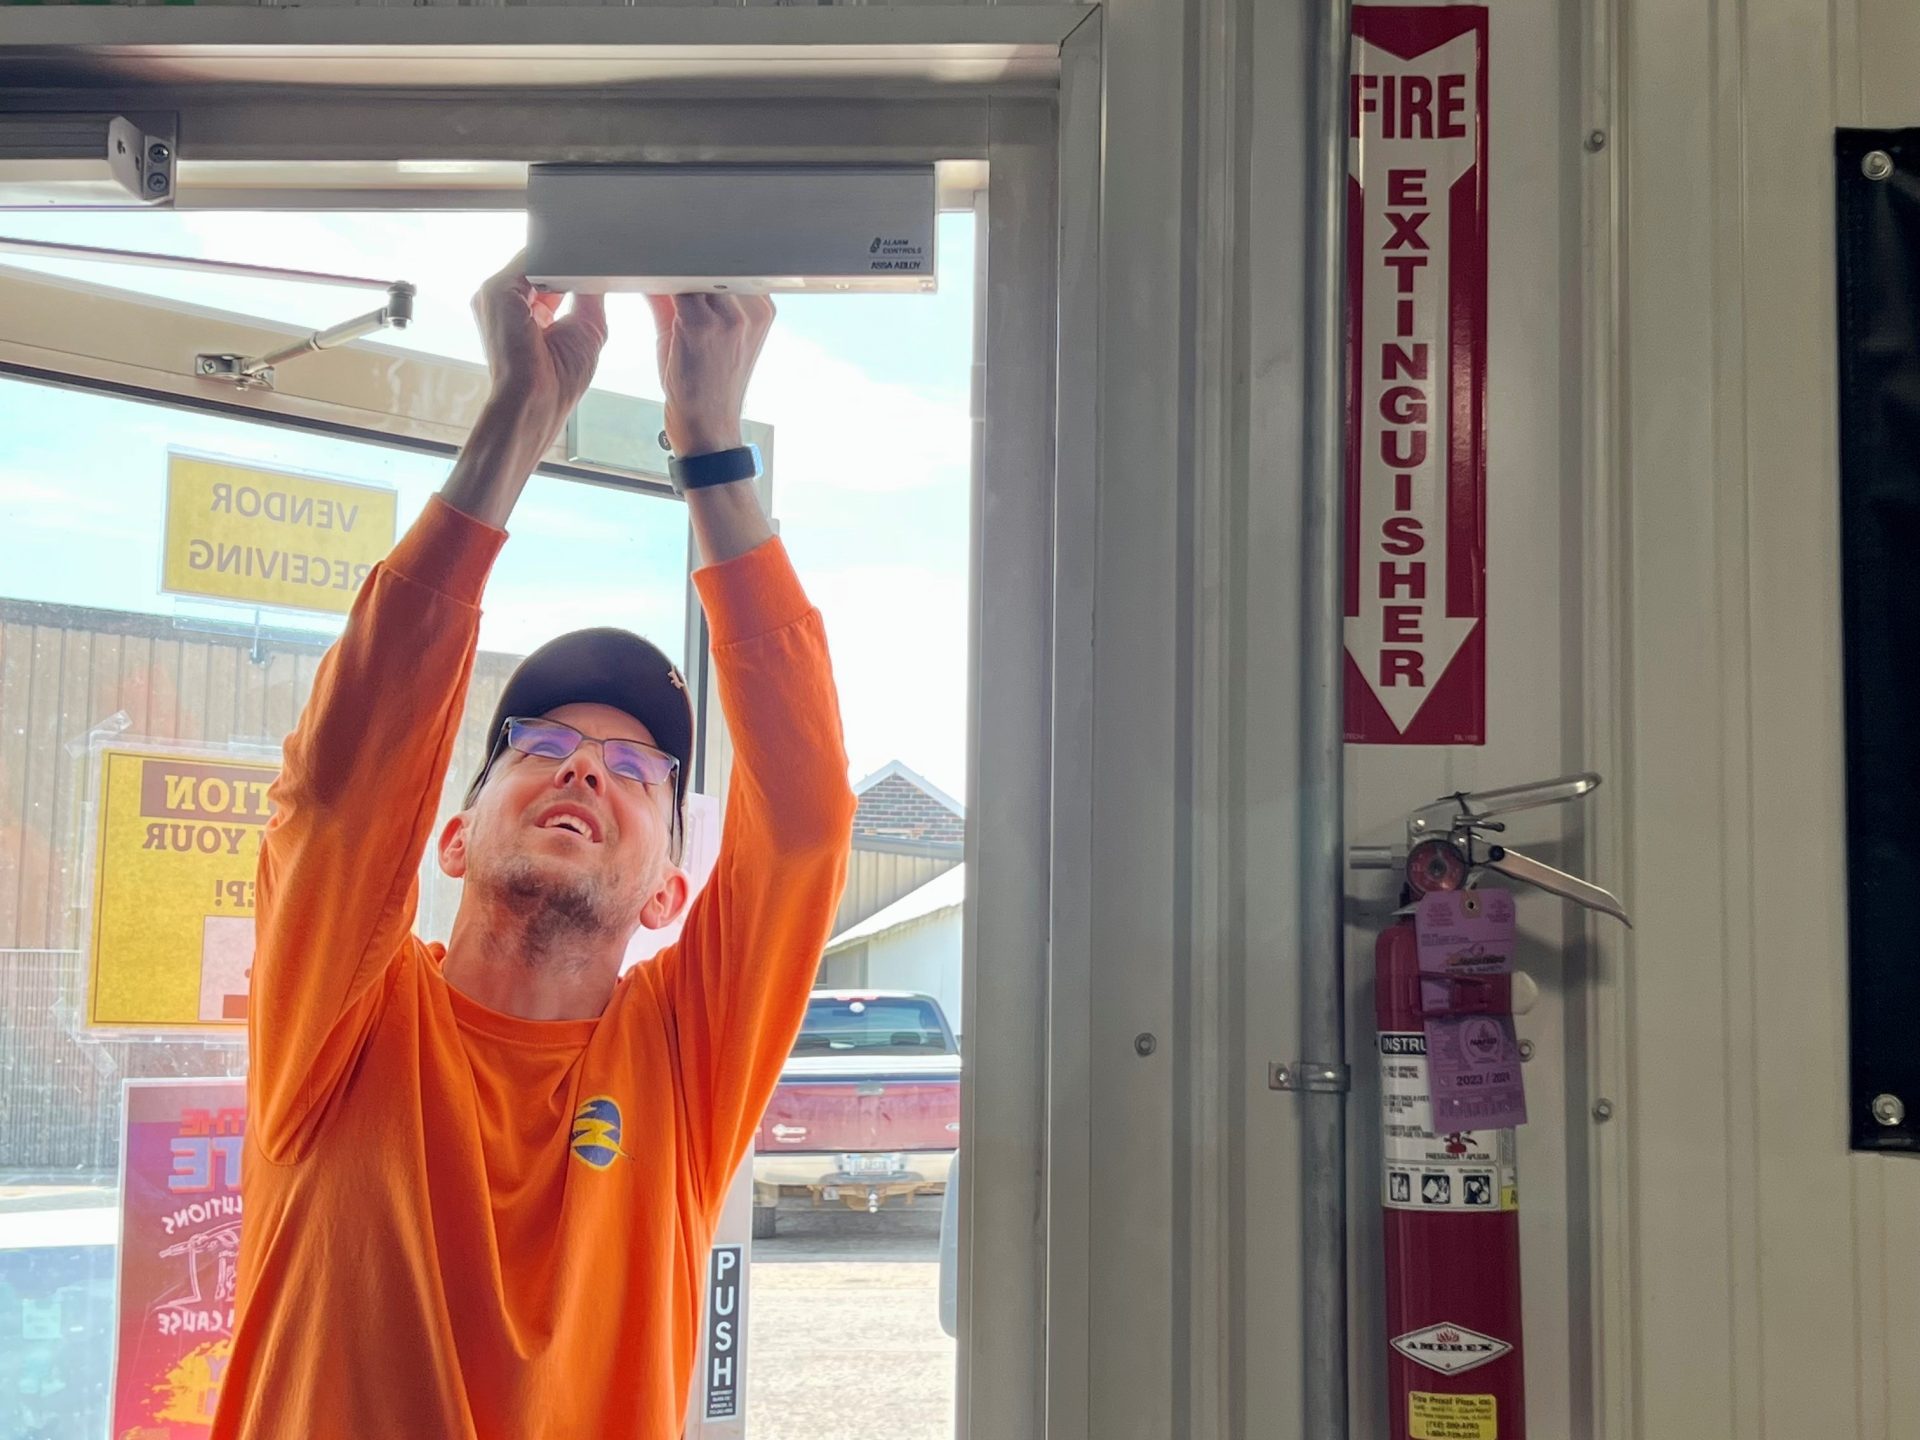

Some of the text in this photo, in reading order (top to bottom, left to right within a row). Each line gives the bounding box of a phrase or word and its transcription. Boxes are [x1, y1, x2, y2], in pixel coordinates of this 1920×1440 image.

[1350, 74, 1466, 139] FIRE
[894, 261, 921, 269] ABLOY
[1379, 168, 1431, 688] EXTINGUISHER
[713, 1252, 735, 1386] PUSH
[1406, 1342, 1493, 1351] AMEREX
